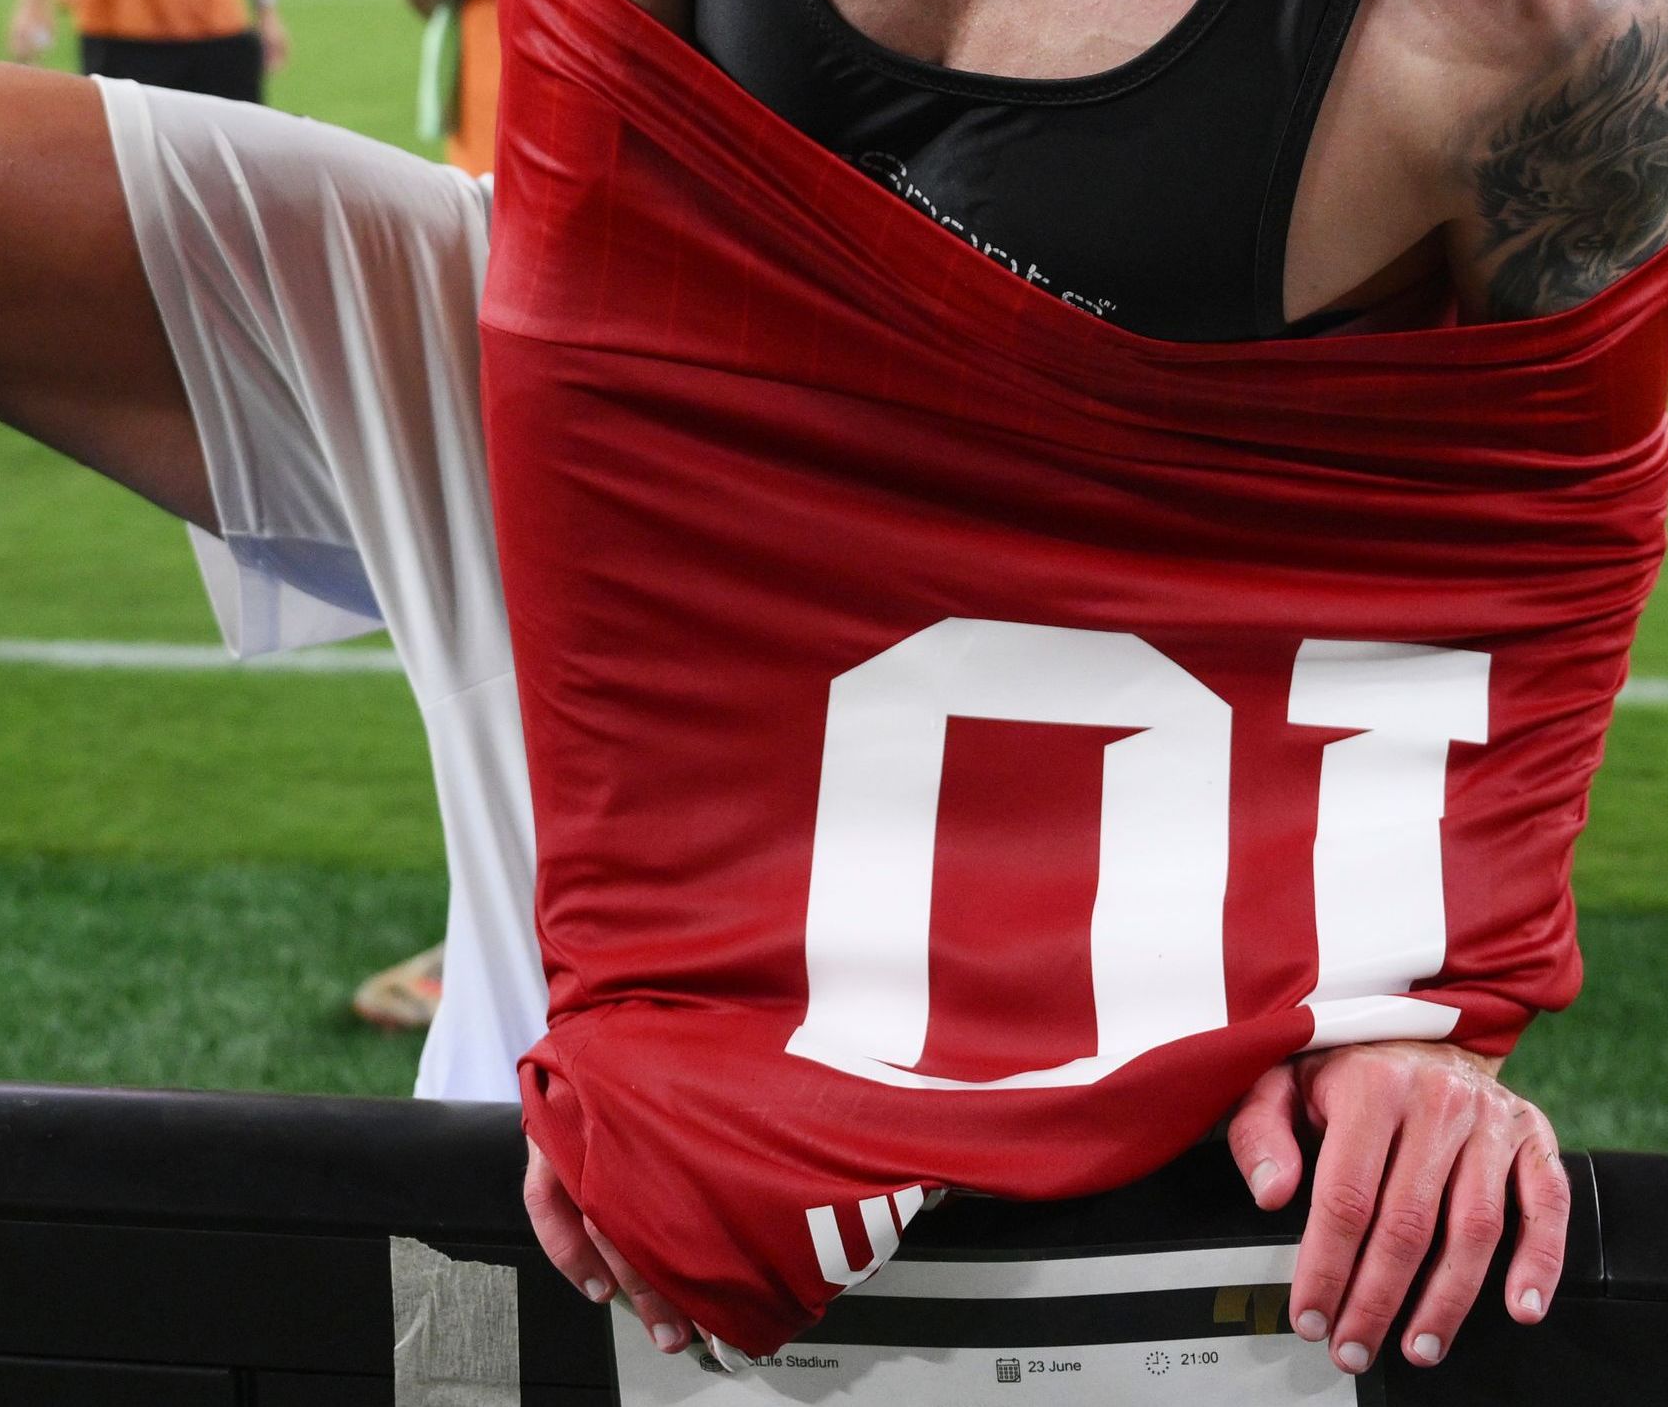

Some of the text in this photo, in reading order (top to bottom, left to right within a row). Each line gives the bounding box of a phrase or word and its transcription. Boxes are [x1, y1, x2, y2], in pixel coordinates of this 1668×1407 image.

[748, 1355, 839, 1369] tLife Stadium
[1180, 1351, 1219, 1365] 21:00
[1027, 1360, 1082, 1373] 23 June
